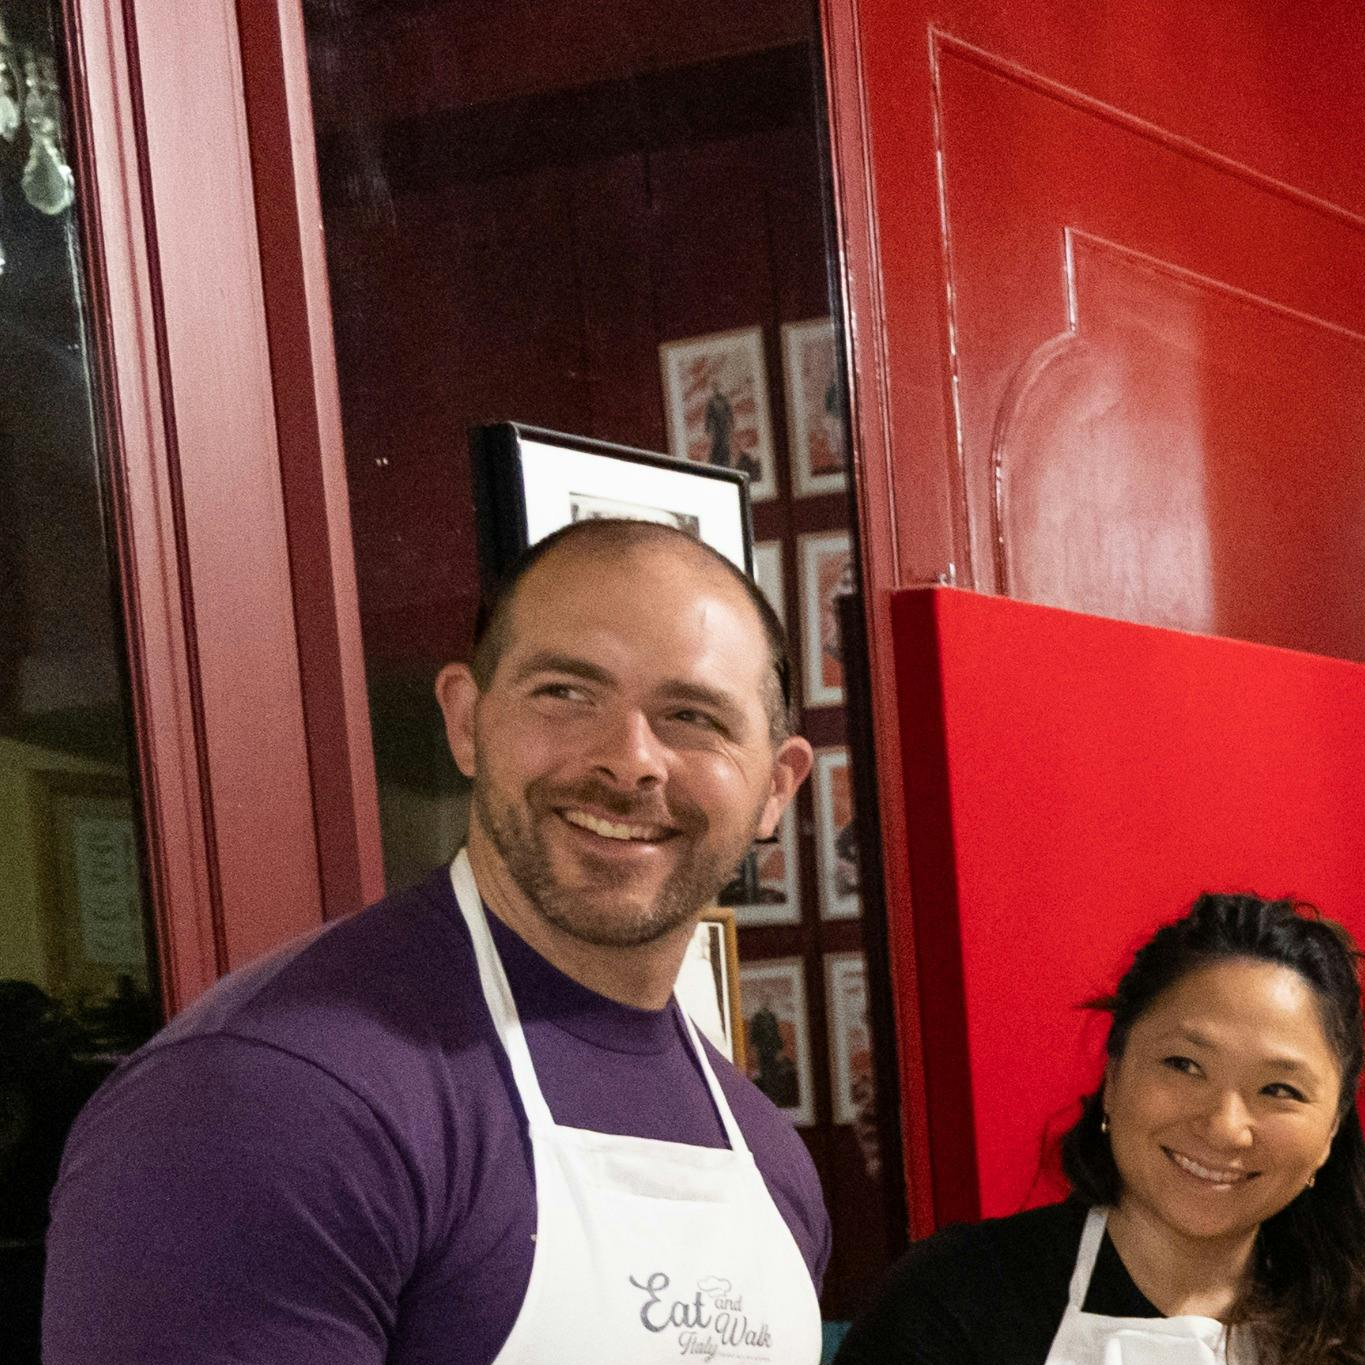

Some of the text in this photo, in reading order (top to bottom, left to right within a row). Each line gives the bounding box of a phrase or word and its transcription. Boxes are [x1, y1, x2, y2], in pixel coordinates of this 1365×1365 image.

[629, 1272, 773, 1349] Eat and Walk
[678, 1331, 718, 1362] Italy
